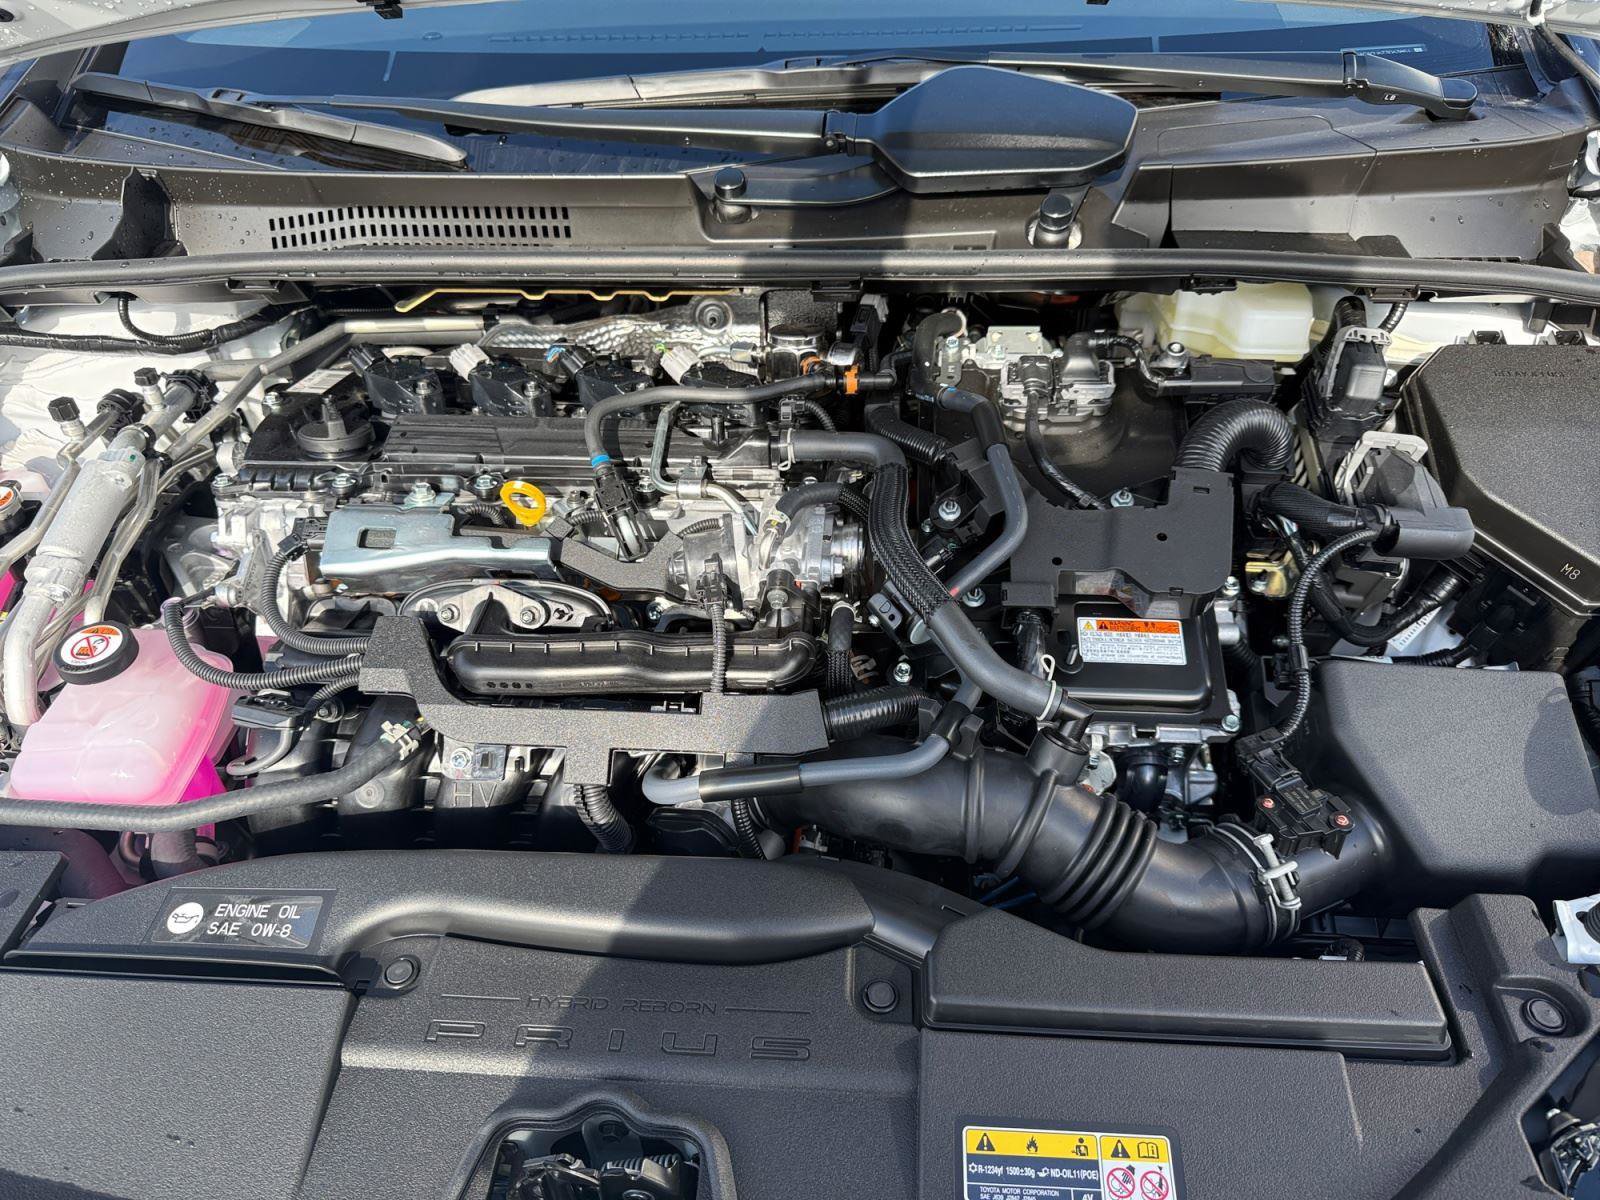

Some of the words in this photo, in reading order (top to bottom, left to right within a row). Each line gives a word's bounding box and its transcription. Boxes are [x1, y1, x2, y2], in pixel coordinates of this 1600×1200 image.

[1560, 563, 1581, 580] M8
[453, 782, 498, 808] HV
[214, 903, 271, 918] ENGINE
[278, 904, 301, 919] OIL
[206, 922, 242, 936] SAE
[250, 923, 292, 938] 0W-8
[526, 994, 610, 1011] HYBRID
[621, 998, 718, 1015] REBORN
[424, 1019, 811, 1061] PRIUS
[979, 1186, 1001, 1194] TOYOTA
[1022, 1188, 1060, 1197] CORPORATION
